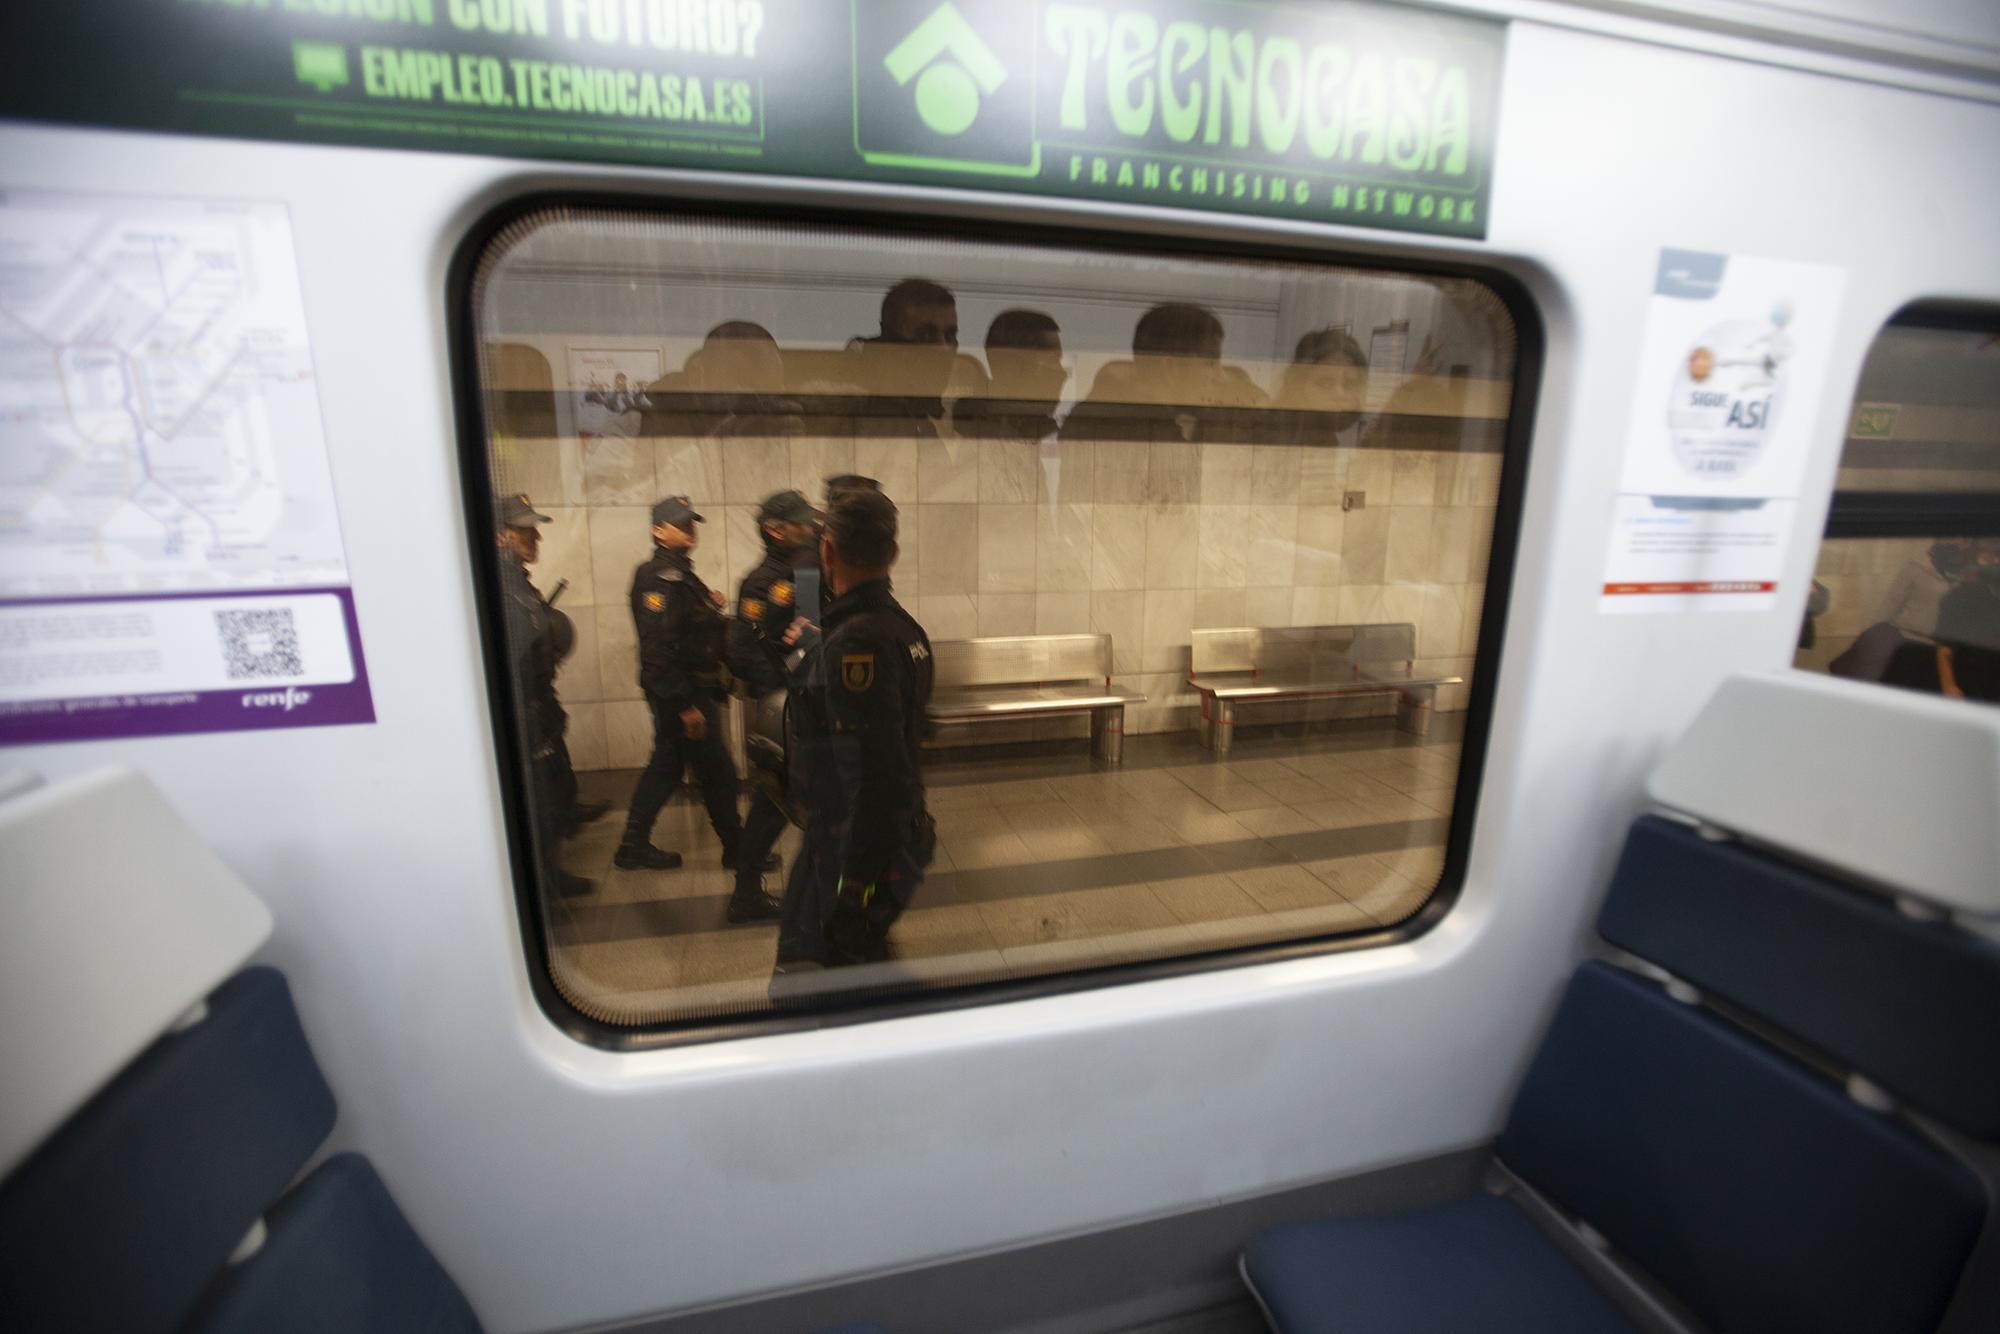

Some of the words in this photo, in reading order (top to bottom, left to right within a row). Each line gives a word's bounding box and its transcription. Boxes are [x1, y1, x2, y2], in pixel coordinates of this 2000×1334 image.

[449, 0, 548, 37] CON
[563, 0, 763, 58] FUTURO?
[360, 45, 752, 126] EMPLEO.TECNOCASA.ES
[1045, 4, 1471, 176] TECNOCASA
[1069, 154, 1311, 206] FRANCHISING
[1331, 183, 1477, 225] NETWORK
[1690, 390, 1729, 408] SIGUE
[1726, 392, 1774, 431] ASÍ
[241, 687, 312, 711] renfe
